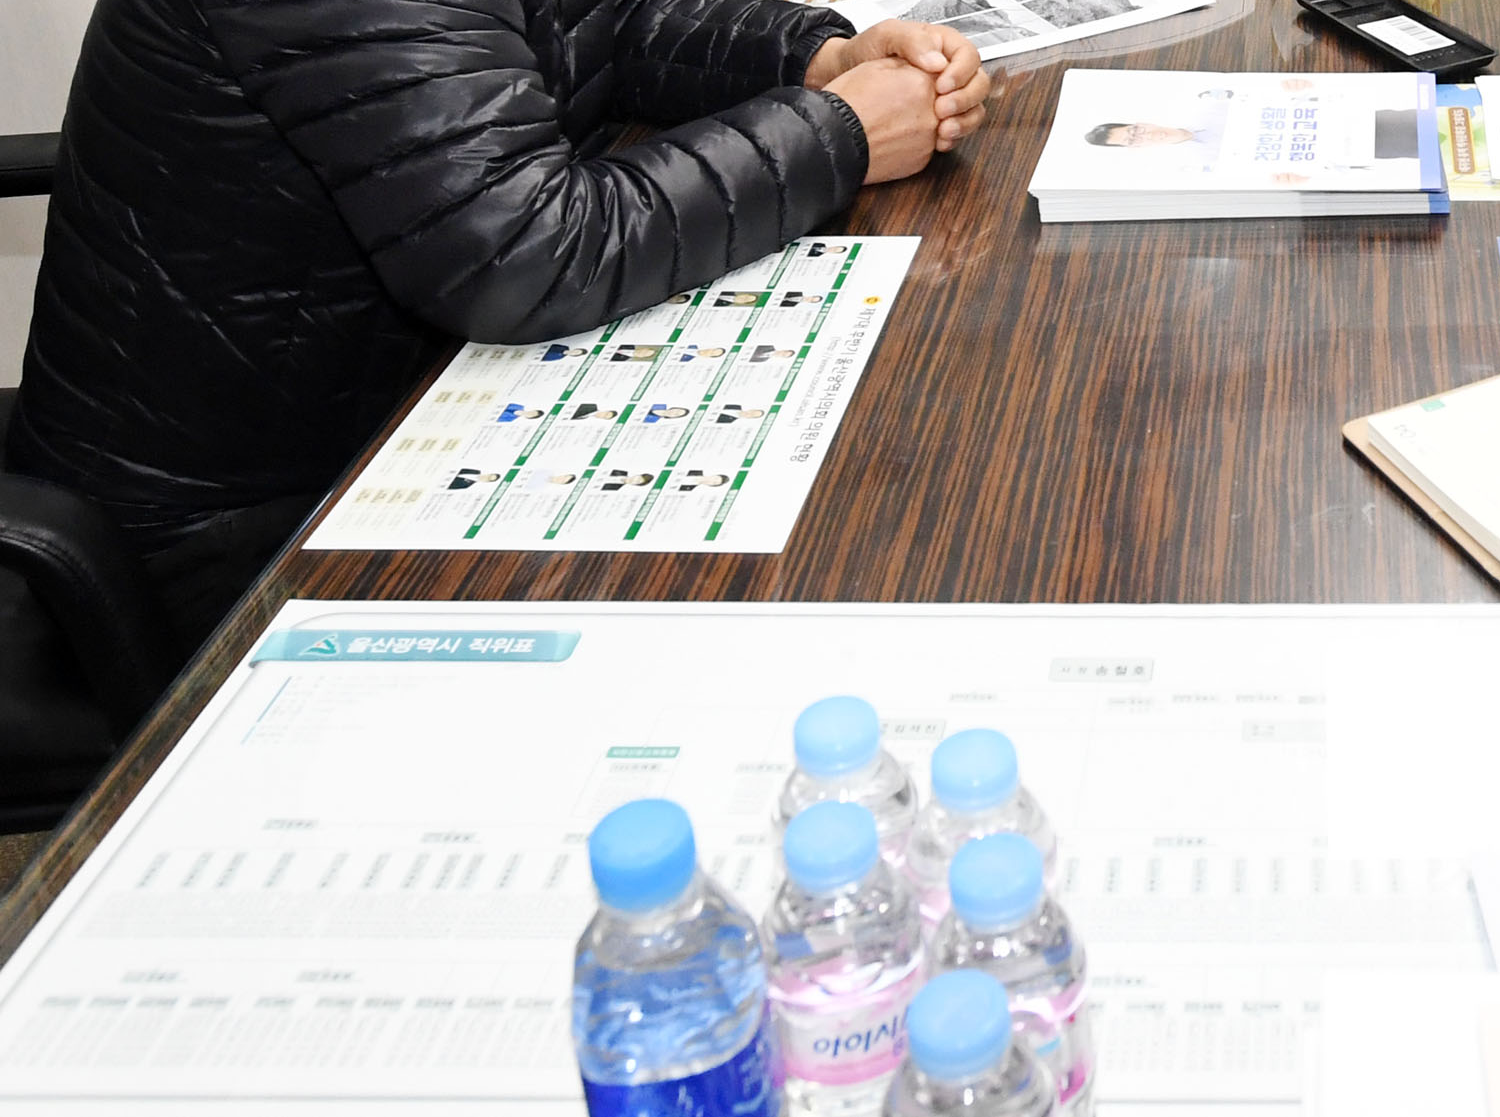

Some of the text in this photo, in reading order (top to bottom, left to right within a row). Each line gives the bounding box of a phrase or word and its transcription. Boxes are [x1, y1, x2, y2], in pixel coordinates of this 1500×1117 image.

[854, 308, 877, 329] 제7대
[810, 357, 854, 419] 울산광역시의회
[800, 421, 824, 440] 의원
[789, 443, 814, 463] 현황
[347, 635, 537, 655] 울산광역시 직위표
